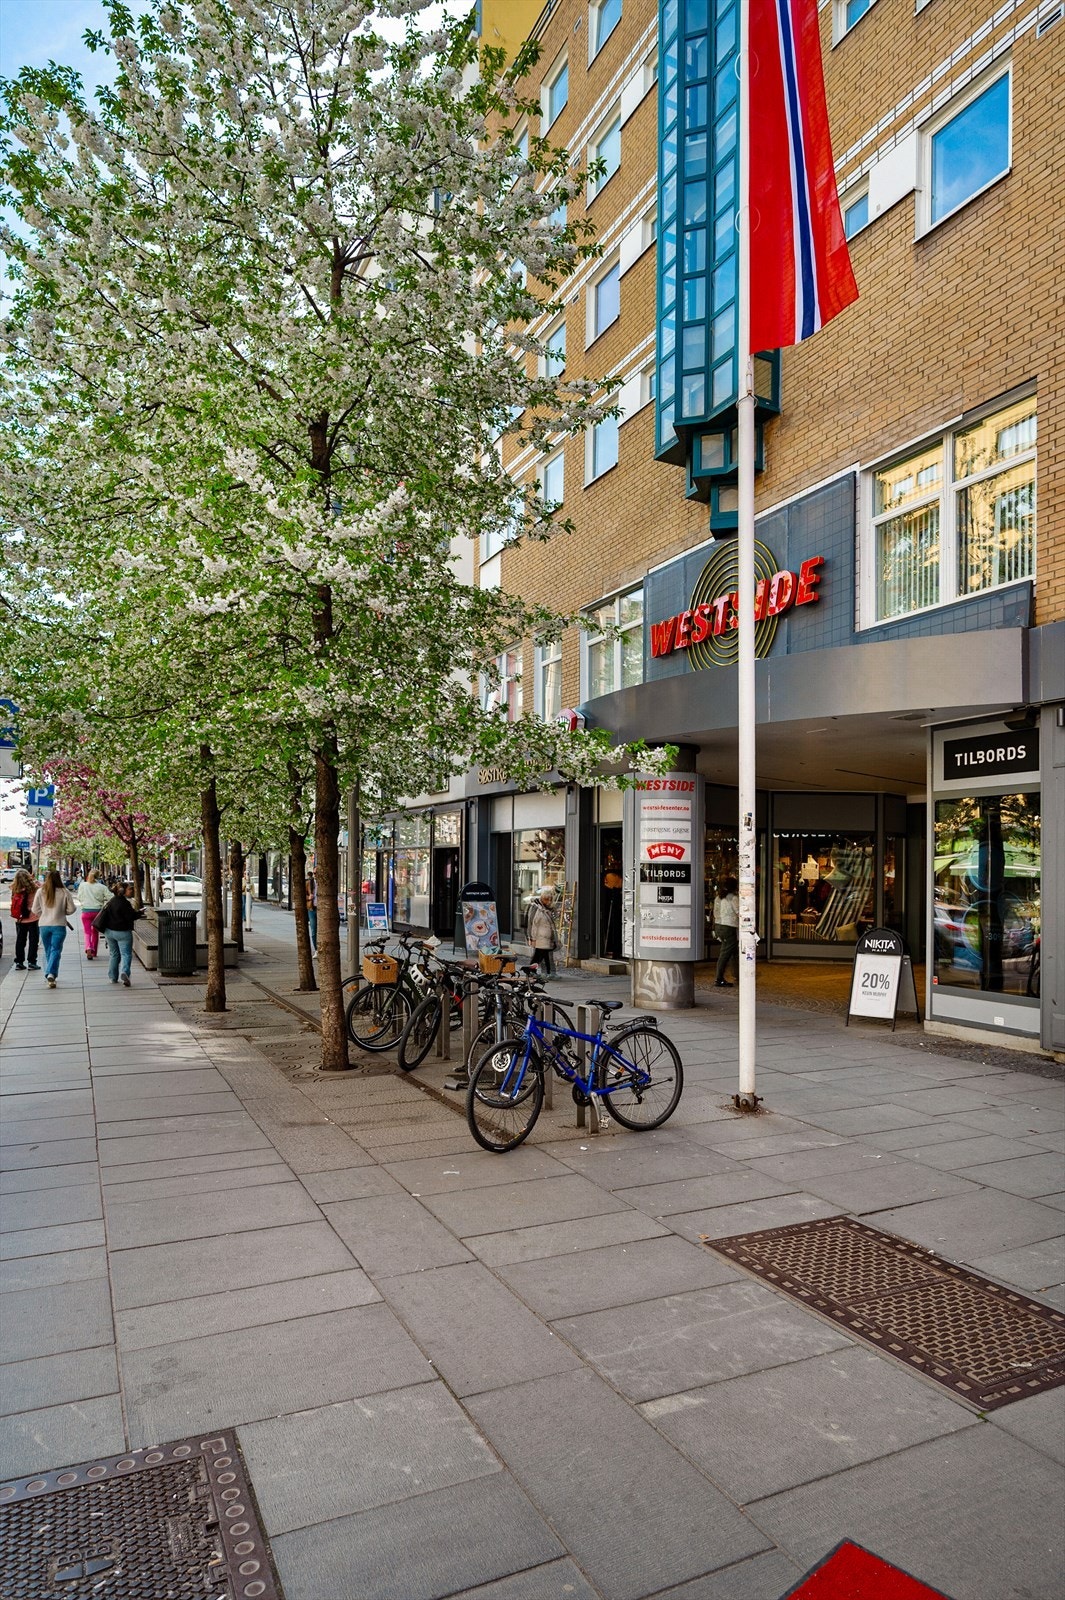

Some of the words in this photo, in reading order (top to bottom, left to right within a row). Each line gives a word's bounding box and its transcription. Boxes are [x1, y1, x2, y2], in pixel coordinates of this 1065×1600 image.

[955, 745, 1027, 767] TILBORDS
[635, 779, 696, 792] WESTSIDE
[34, 787, 48, 803] P
[651, 845, 682, 856] MENY
[645, 869, 686, 878] TILBORDS
[865, 939, 896, 950] NIKITA
[861, 972, 890, 990] 20%
